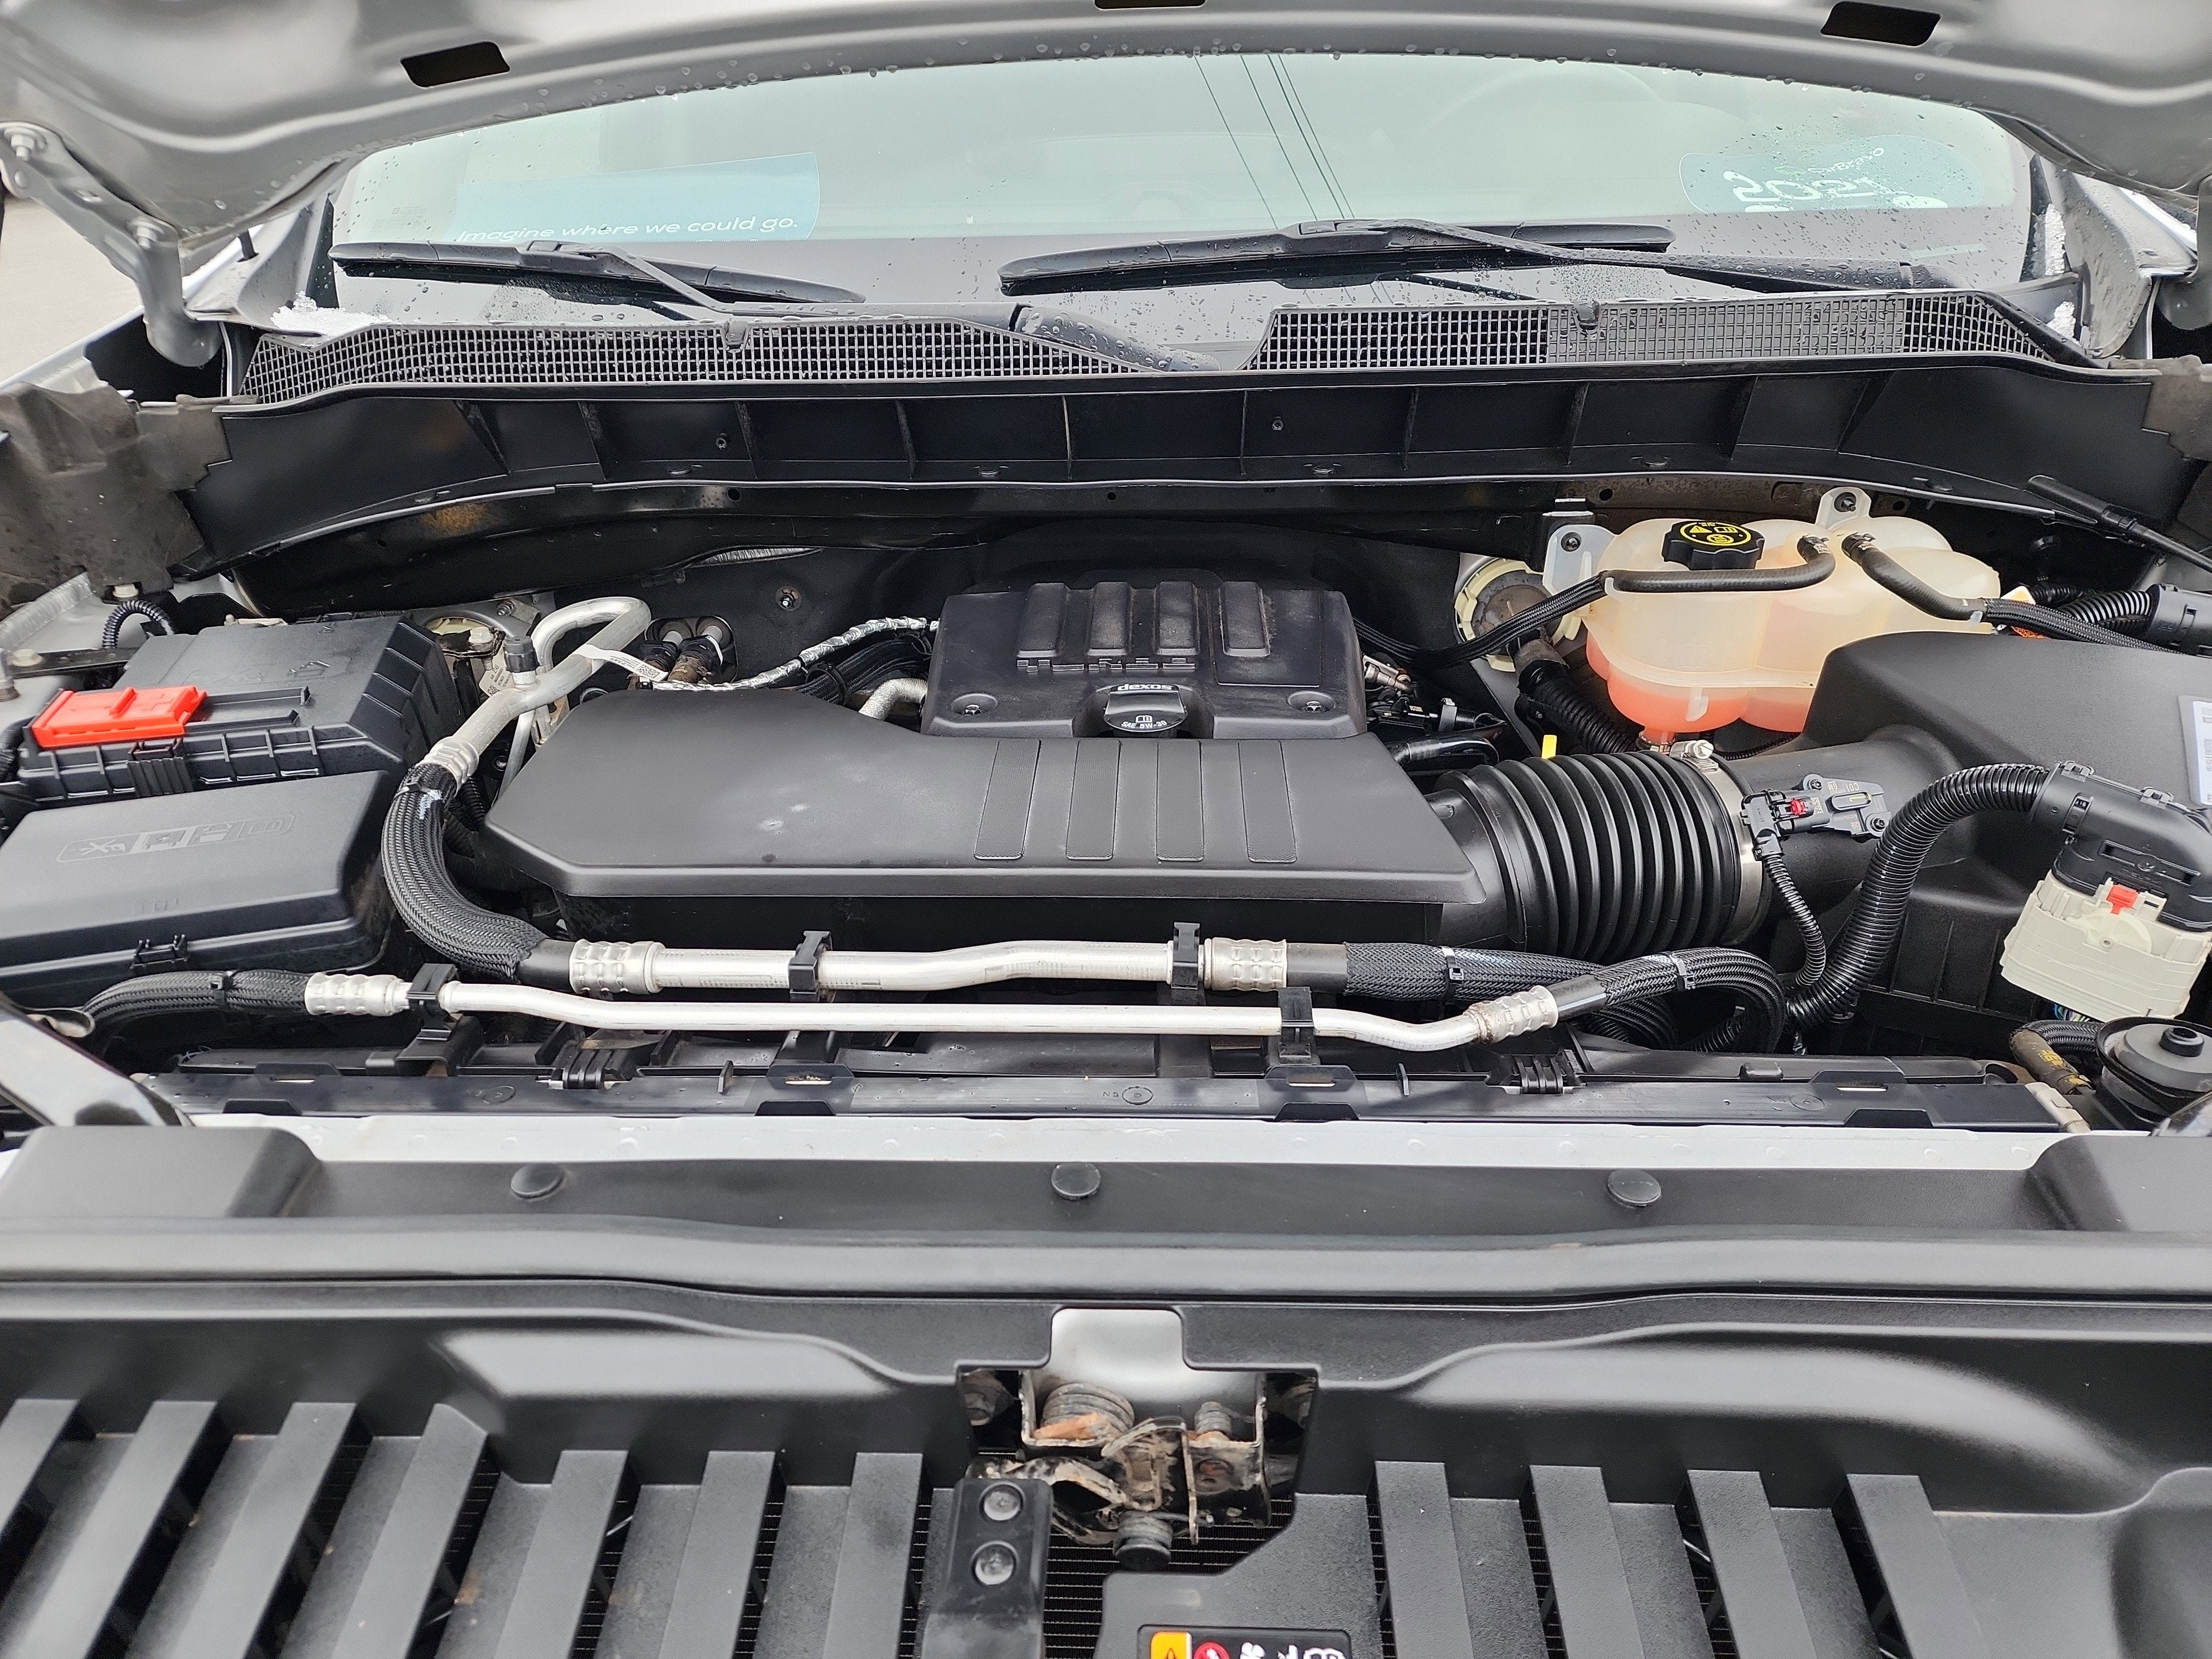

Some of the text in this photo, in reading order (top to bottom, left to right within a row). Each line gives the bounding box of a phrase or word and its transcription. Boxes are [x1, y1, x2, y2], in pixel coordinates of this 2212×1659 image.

[1723, 171, 1908, 202] 2021
[455, 216, 798, 242] Imagine where we could go.
[1827, 781, 1838, 791] GM
